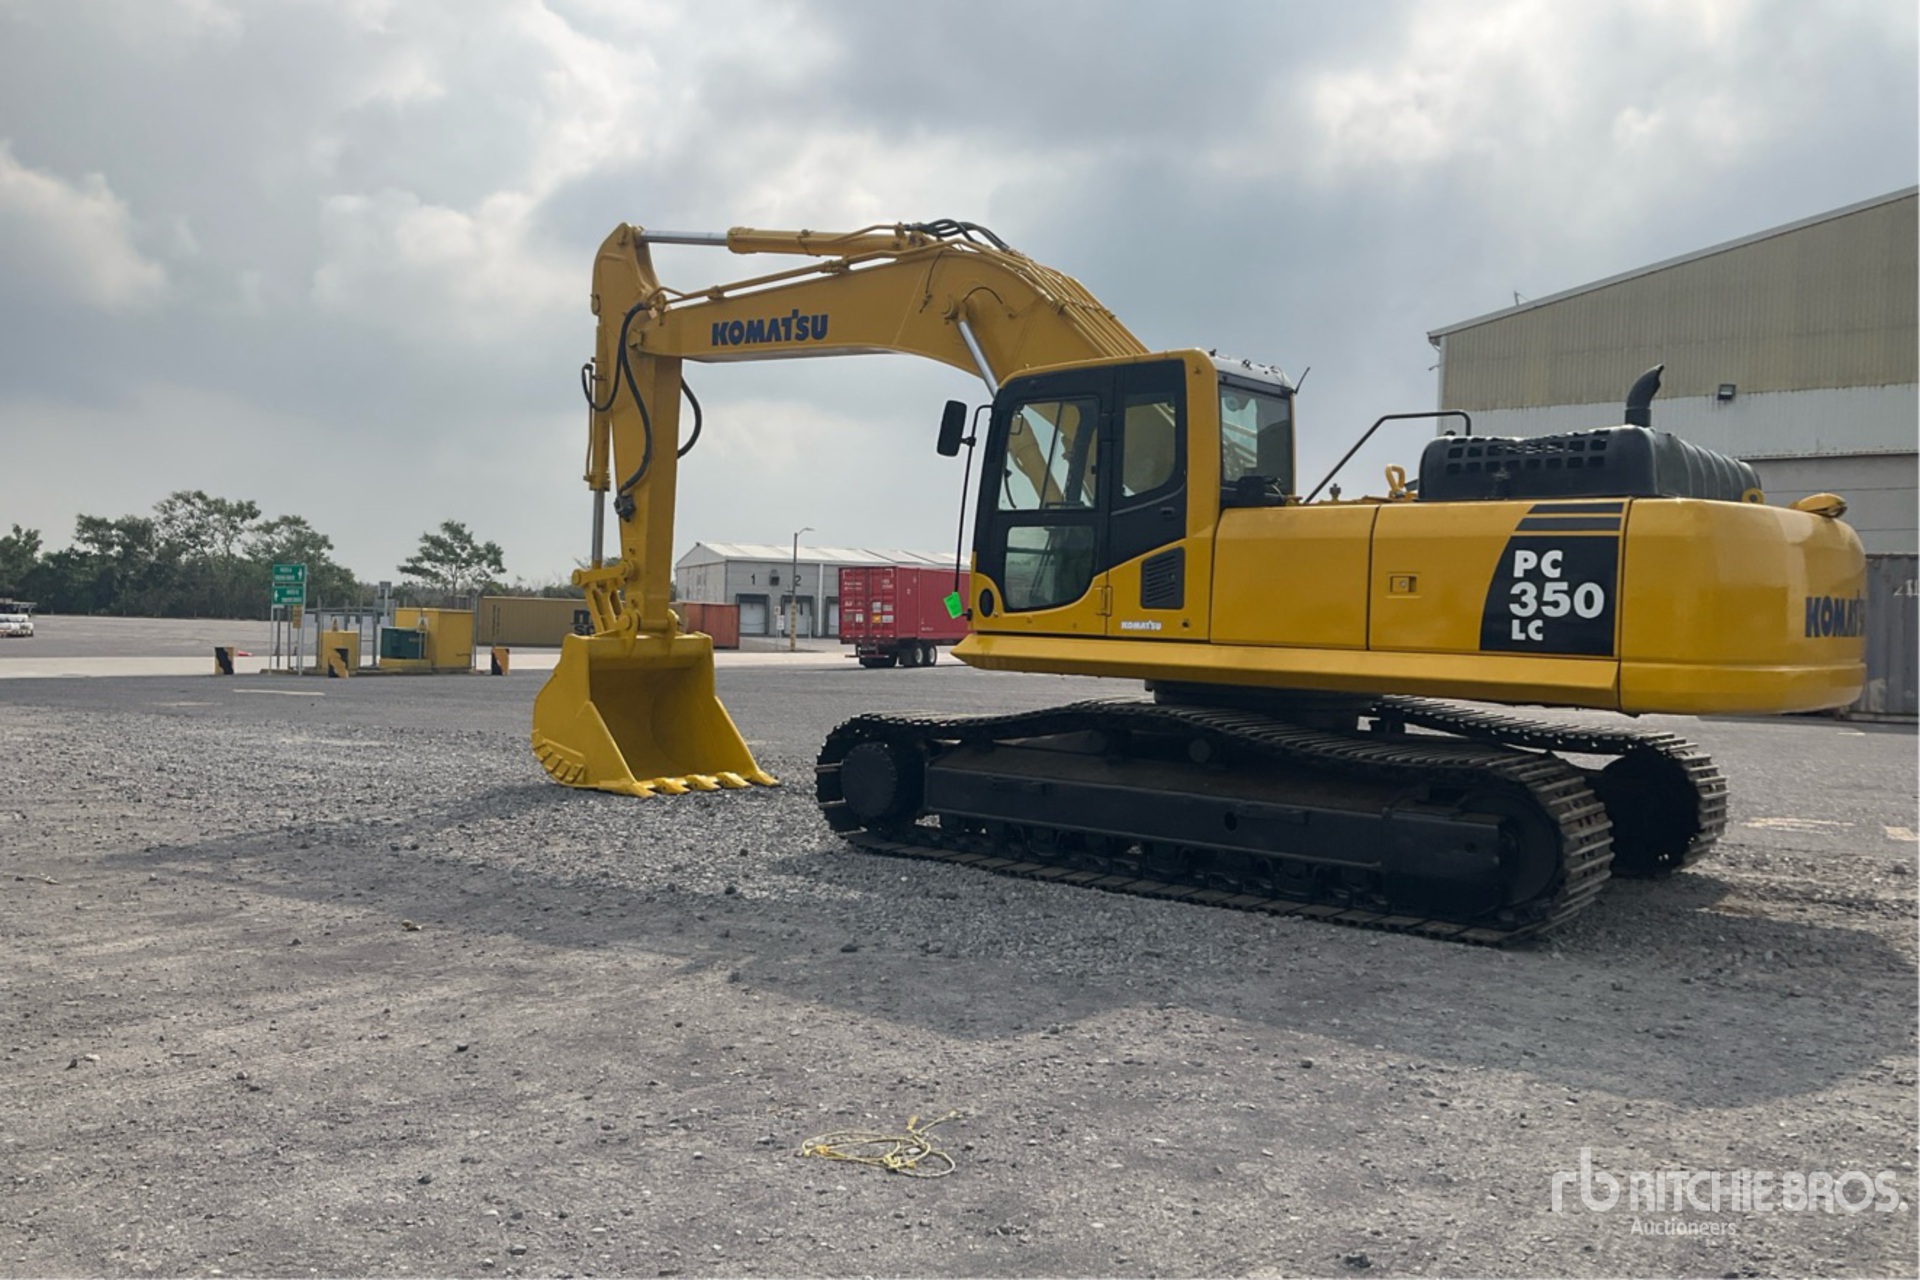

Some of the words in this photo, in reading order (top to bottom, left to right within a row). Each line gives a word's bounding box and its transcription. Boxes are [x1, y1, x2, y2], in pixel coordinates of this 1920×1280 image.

[711, 308, 828, 347] KOMATSU
[1513, 549, 1563, 578] PC
[751, 573, 756, 586] 1
[794, 574, 802, 587] 2
[1508, 581, 1605, 619] 350
[1121, 619, 1162, 631] KOMATSU
[1805, 589, 1866, 638] KOMAT
[1511, 619, 1544, 641] LC
